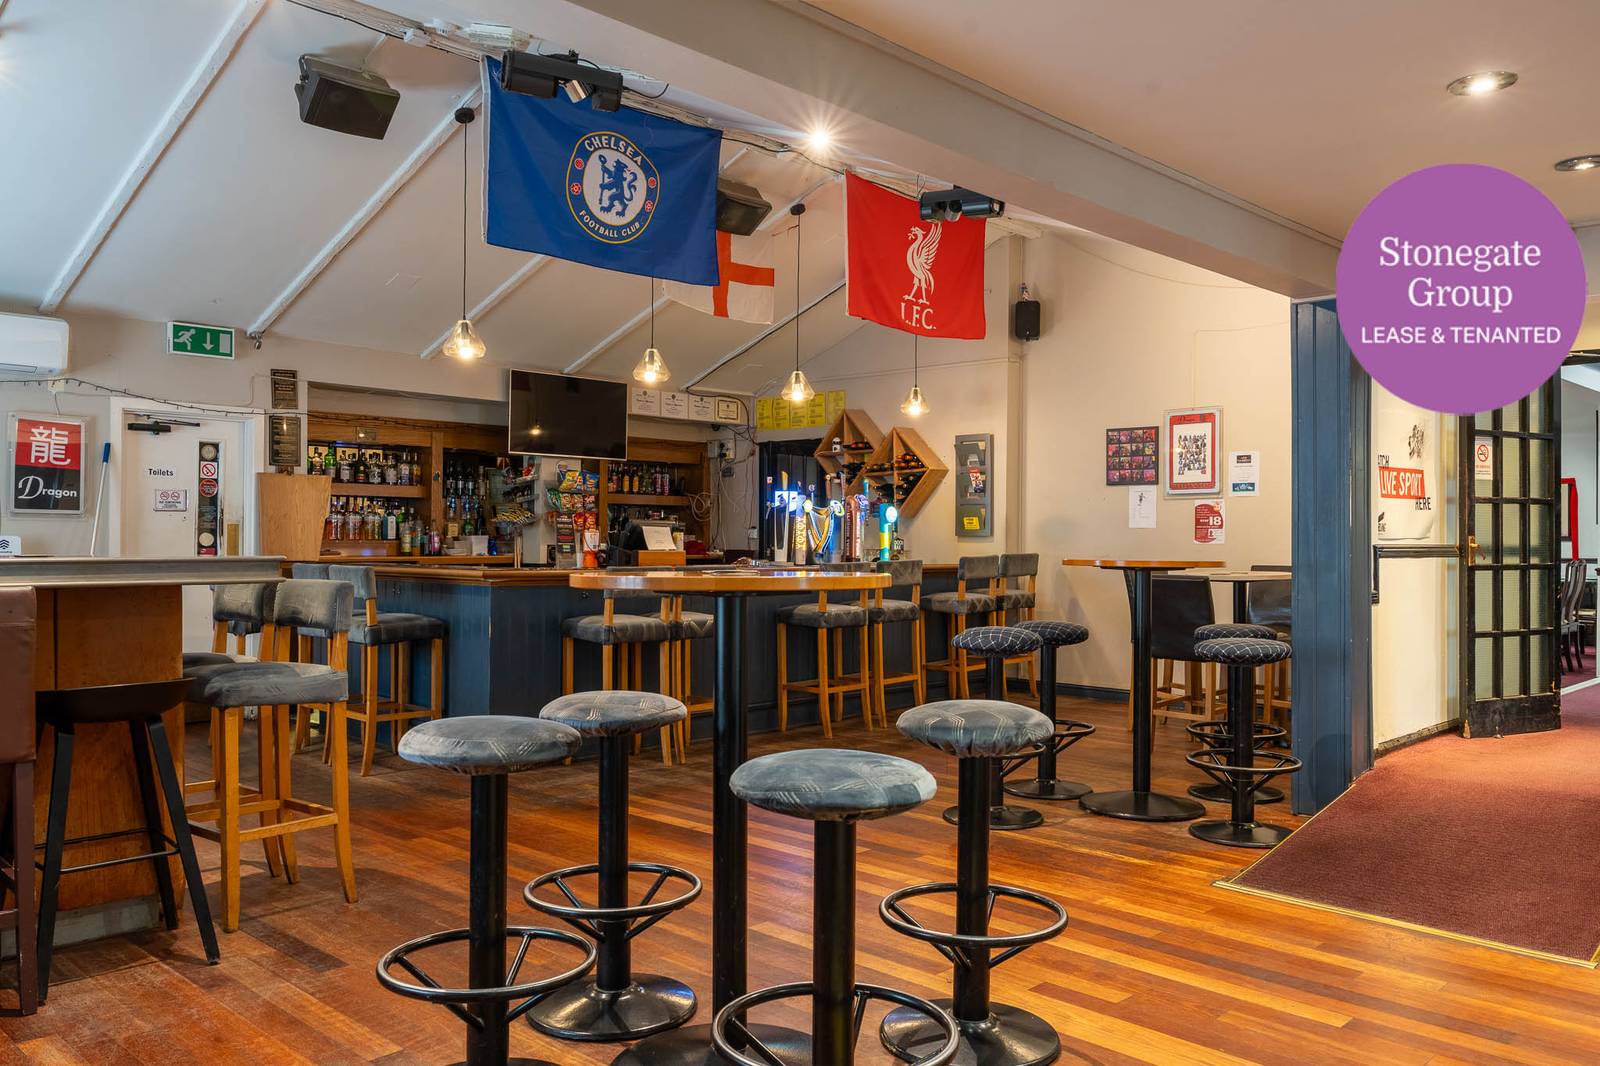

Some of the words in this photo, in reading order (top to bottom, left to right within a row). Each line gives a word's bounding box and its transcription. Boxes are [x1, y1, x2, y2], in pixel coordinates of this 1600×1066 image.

[584, 136, 642, 166] CHELSEA
[580, 210, 618, 237] FOOTBALL
[621, 222, 640, 237] CLUB
[30, 426, 71, 465] 龍
[148, 468, 174, 476] Toilets
[1380, 470, 1398, 496] LIVE
[1399, 471, 1423, 497] SPORT
[18, 475, 77, 499] Dragon
[1415, 497, 1431, 510] HERE
[1209, 516, 1222, 526] 18
